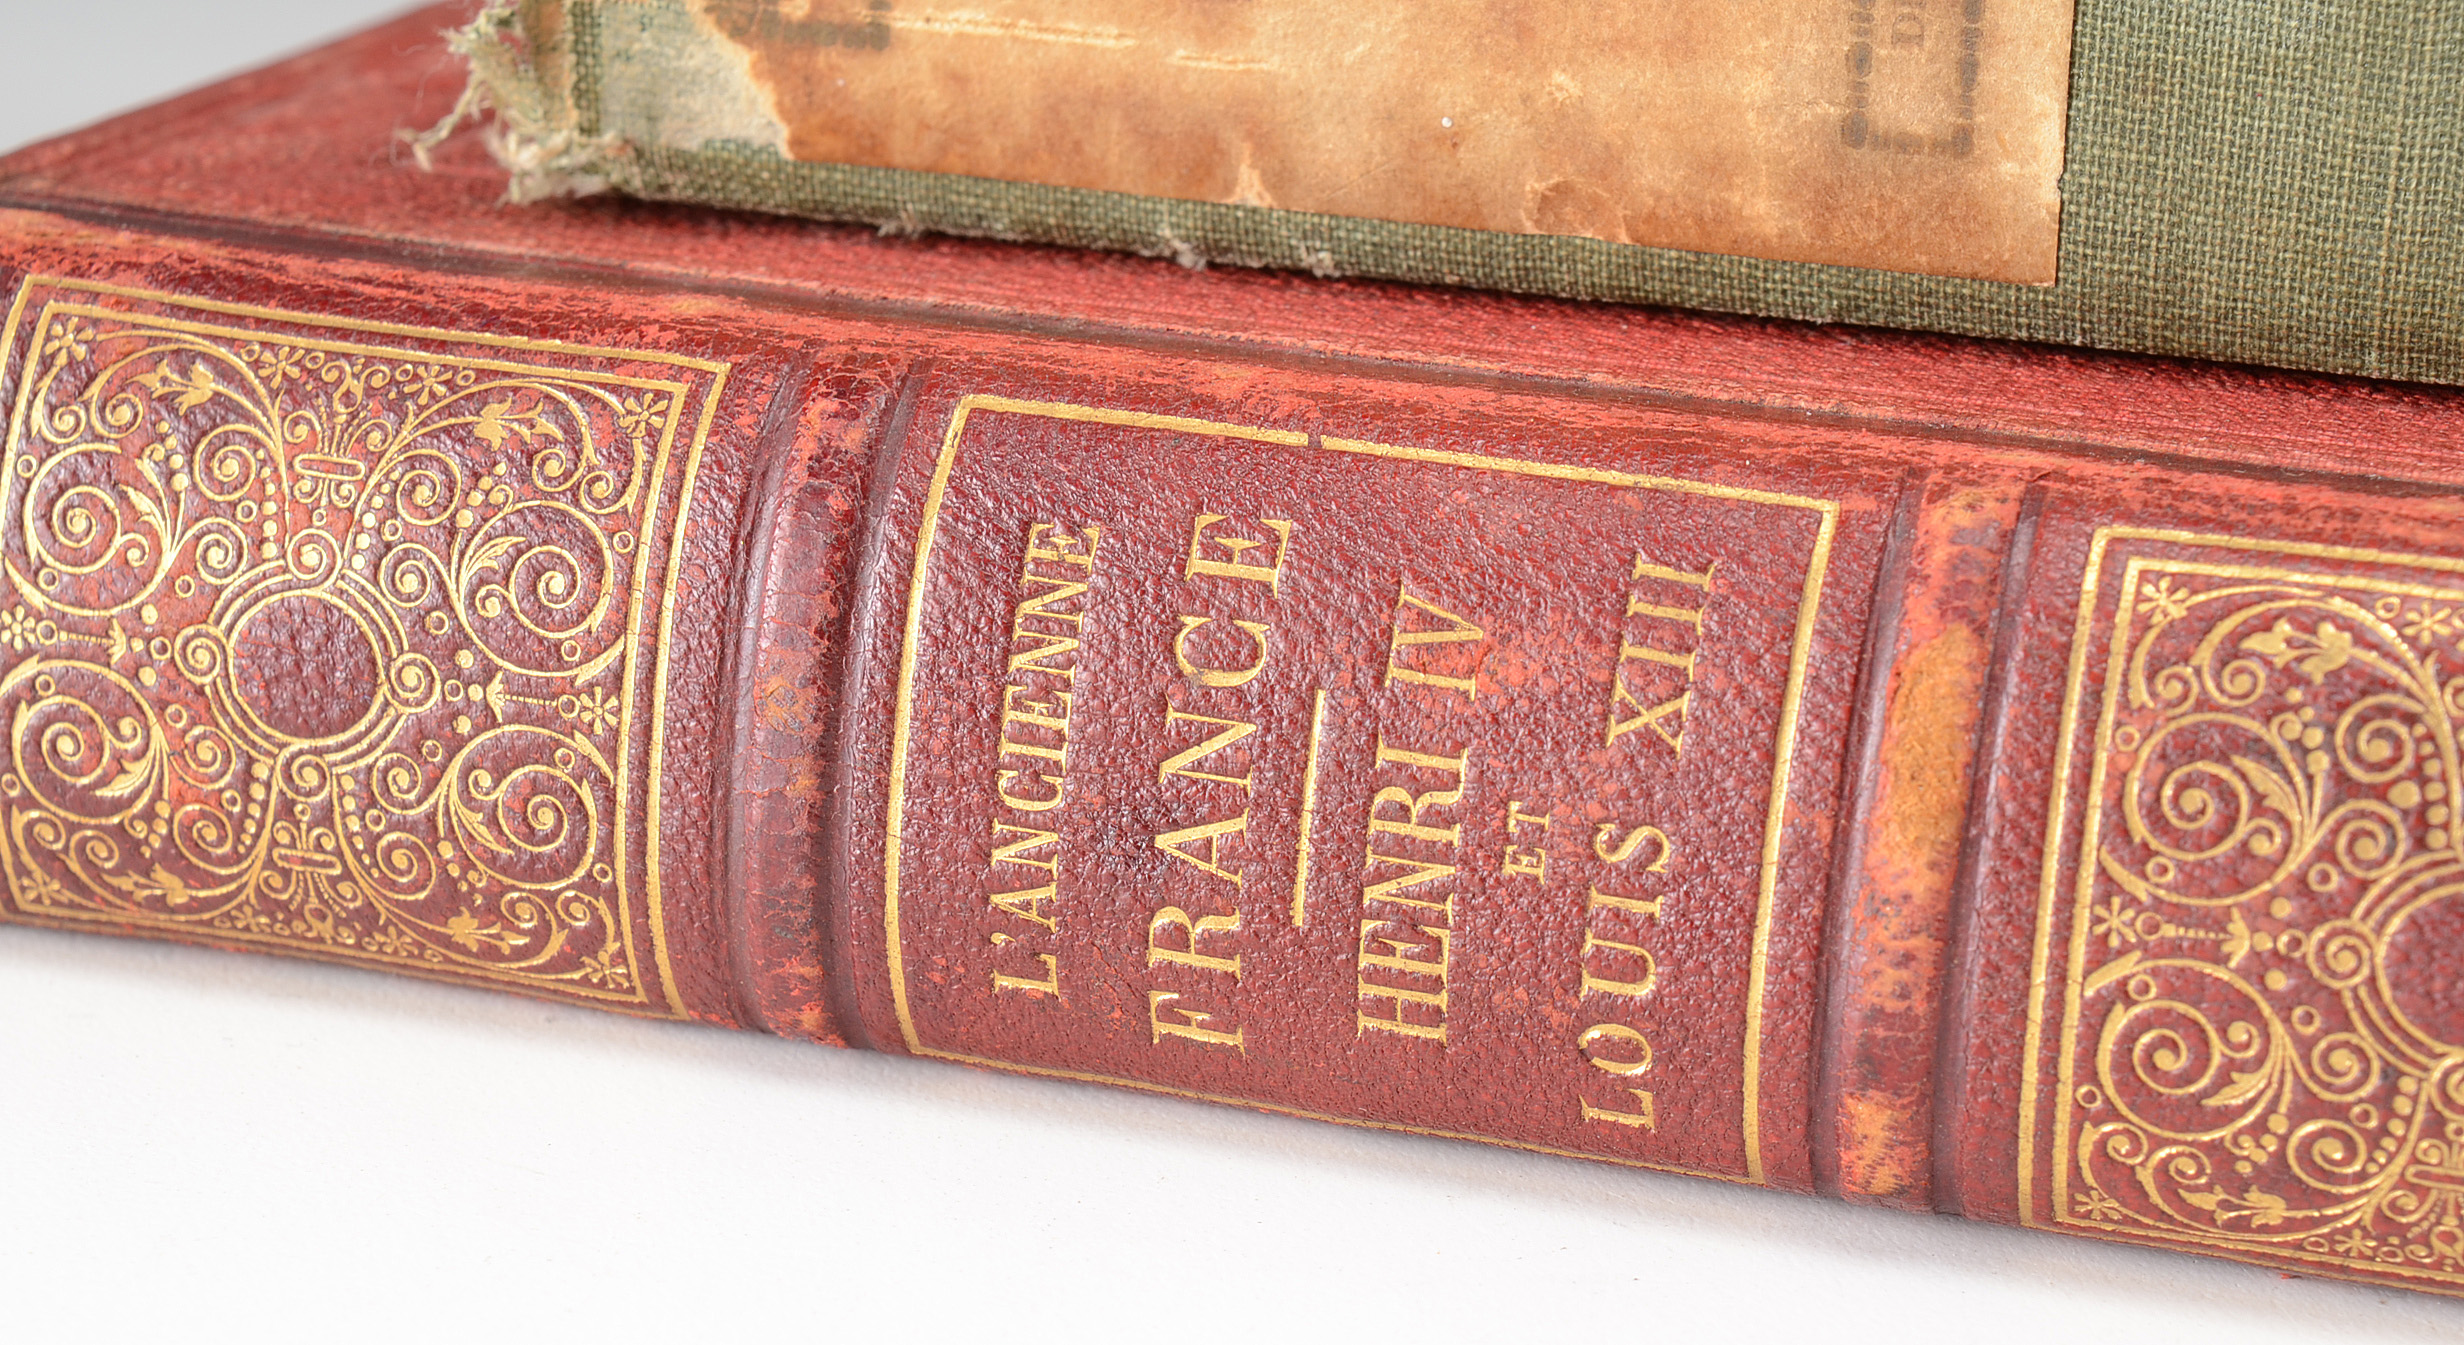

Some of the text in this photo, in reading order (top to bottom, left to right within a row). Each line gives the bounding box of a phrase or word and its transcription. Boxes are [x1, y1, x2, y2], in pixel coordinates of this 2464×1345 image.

[989, 522, 1101, 1001] L'ANCIENNE
[1145, 512, 1292, 1055] FRANCE
[1357, 584, 1484, 1047] HENRI IV
[1504, 801, 1550, 884] ET
[1577, 552, 1715, 1131] LOUIS XIII
